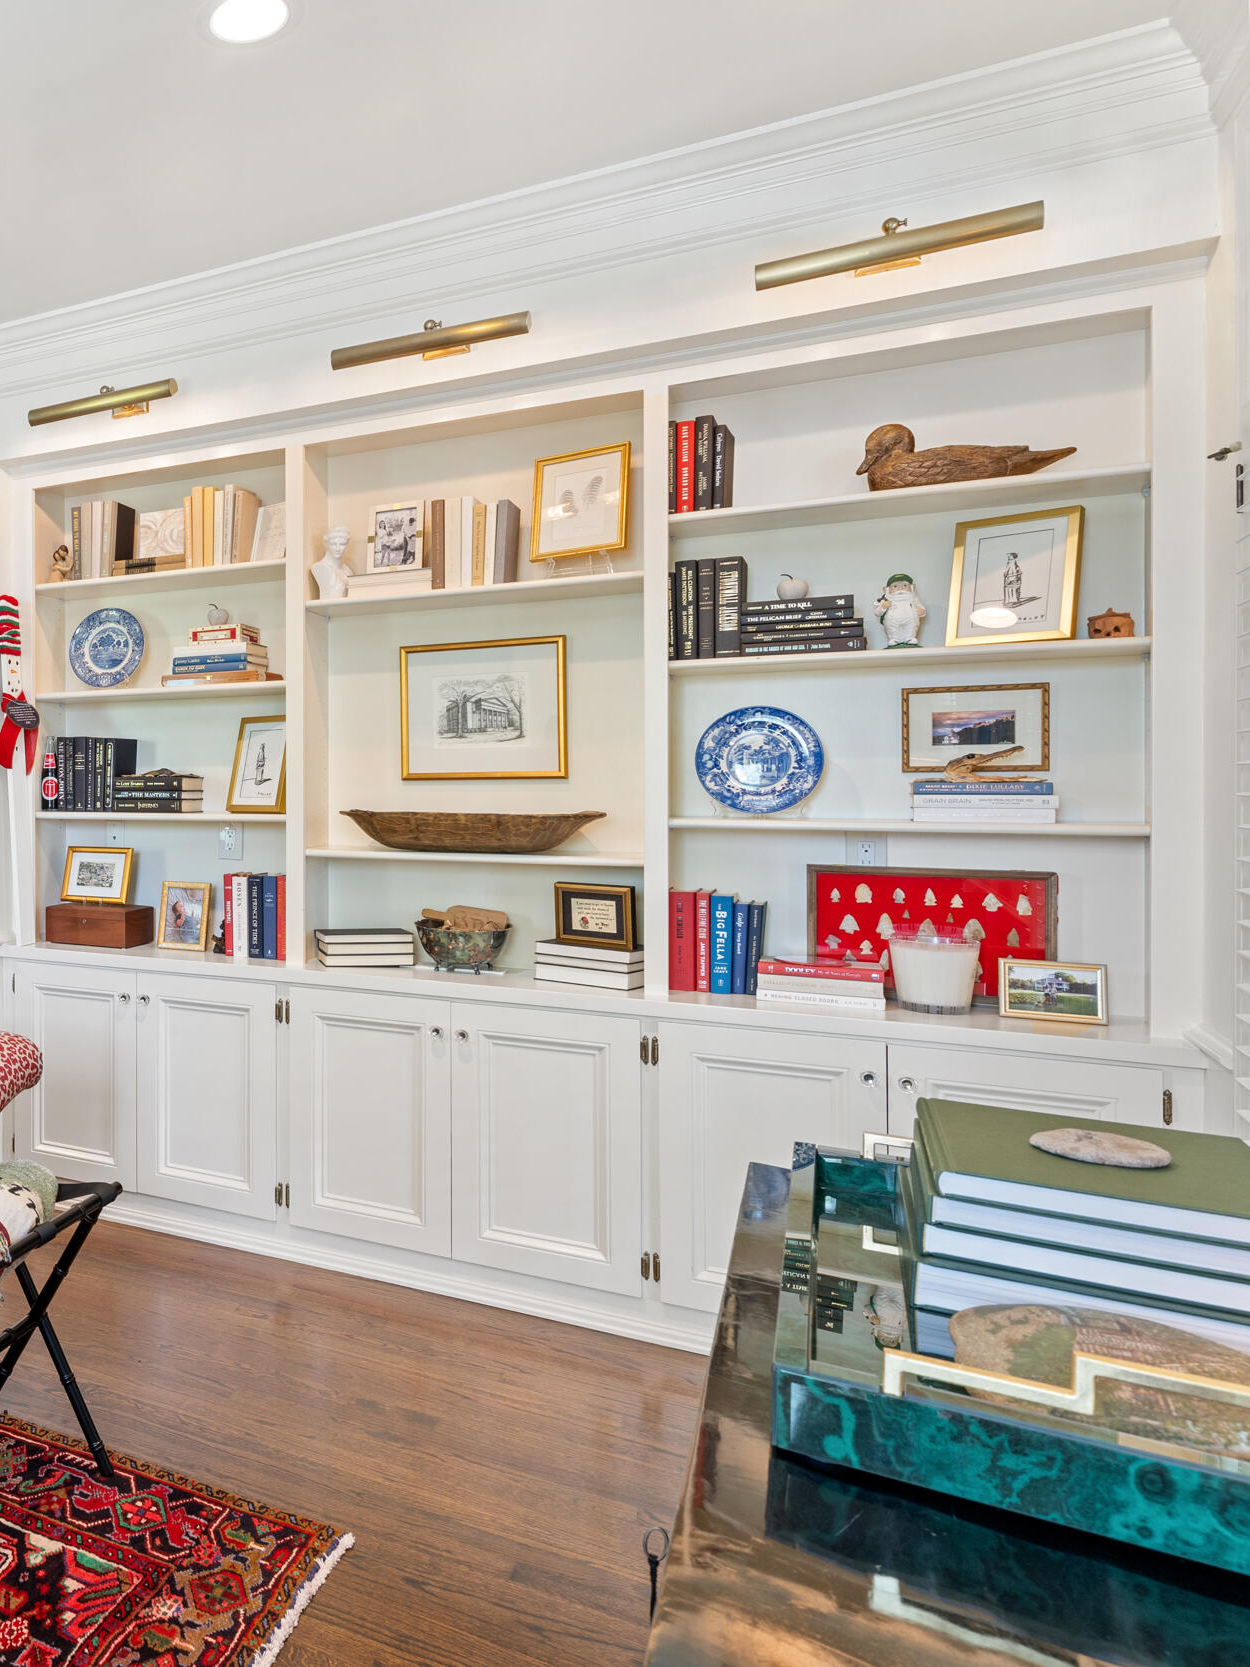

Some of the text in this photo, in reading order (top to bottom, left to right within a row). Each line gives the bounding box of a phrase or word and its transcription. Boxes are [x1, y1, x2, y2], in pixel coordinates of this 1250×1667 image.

[719, 571, 738, 604] STONEWALL
[797, 601, 812, 610] KILL
[719, 606, 738, 631] JACKSON
[59, 742, 64, 753] ME
[699, 900, 707, 908] THE
[699, 908, 707, 927] HELLFIRE
[716, 911, 727, 928] BIG
[736, 912, 744, 927] Gulp
[716, 931, 727, 960] FELLA
